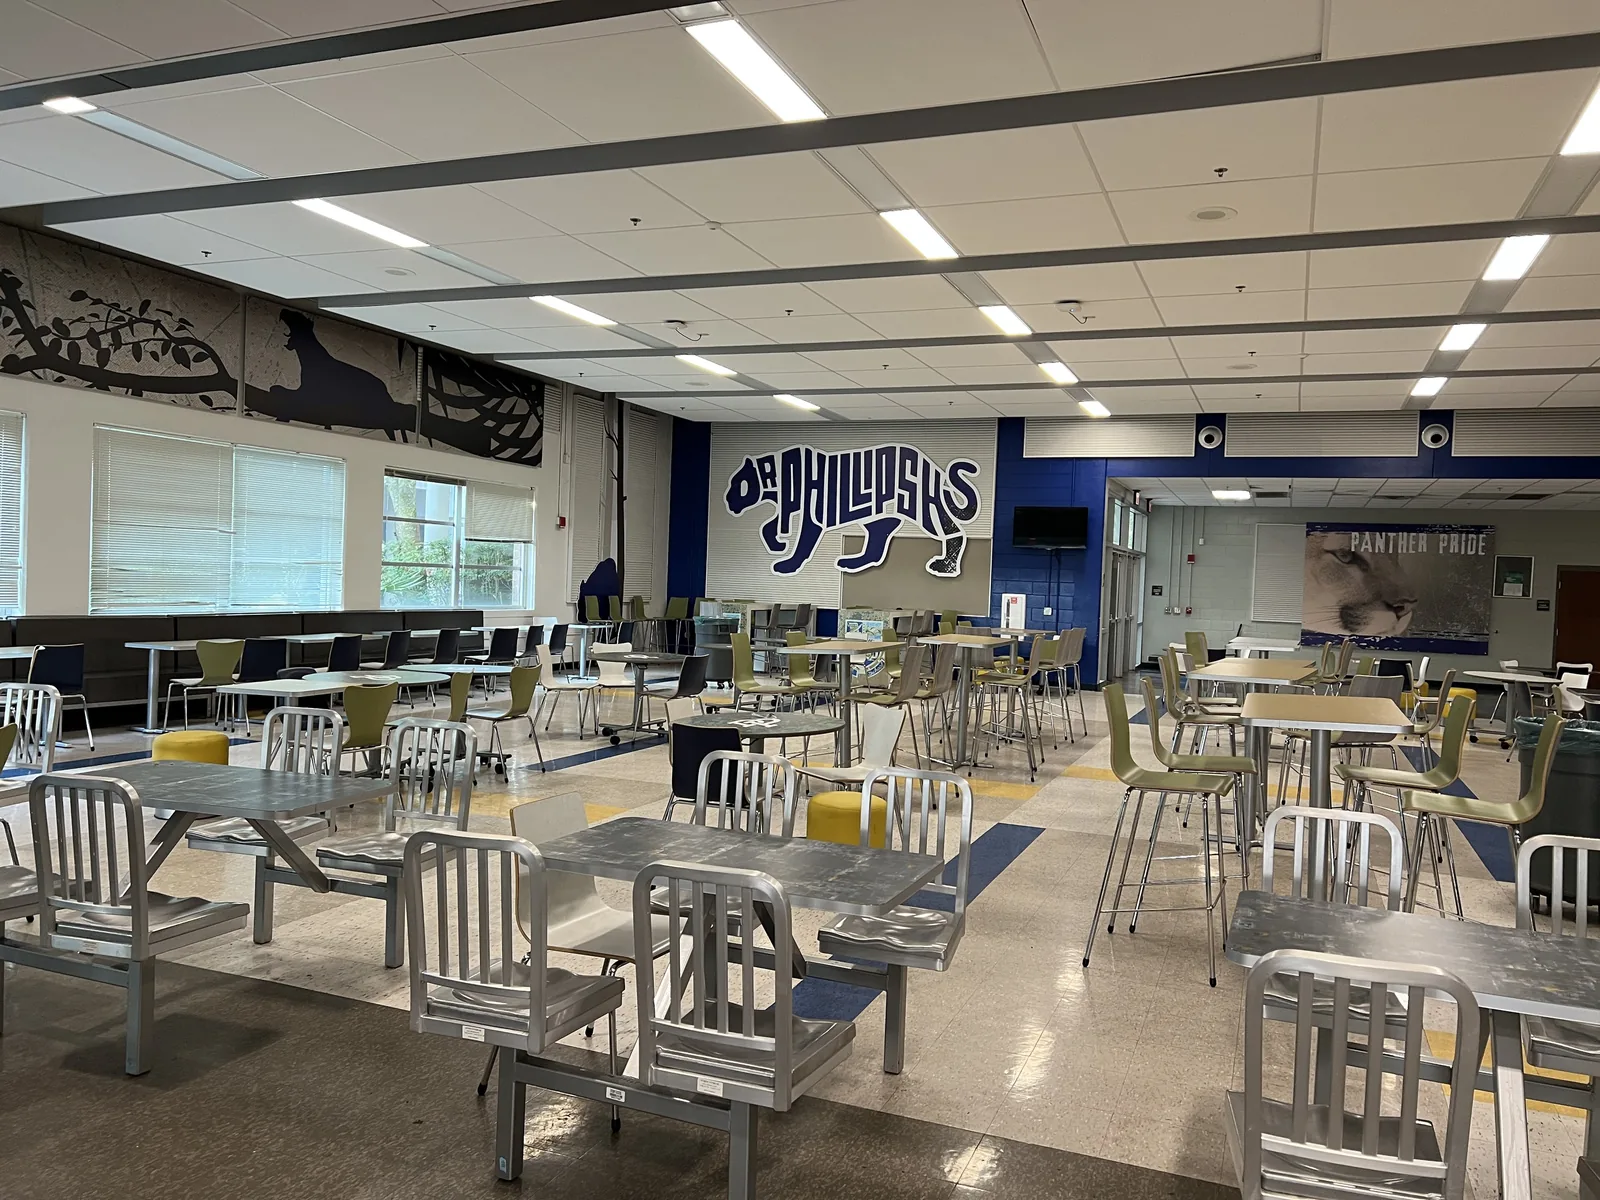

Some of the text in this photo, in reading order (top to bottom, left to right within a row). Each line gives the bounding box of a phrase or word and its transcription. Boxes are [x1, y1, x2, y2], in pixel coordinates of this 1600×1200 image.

[775, 445, 918, 572] PHILLIPS
[1350, 531, 1487, 556] PANTHER PRIDE
